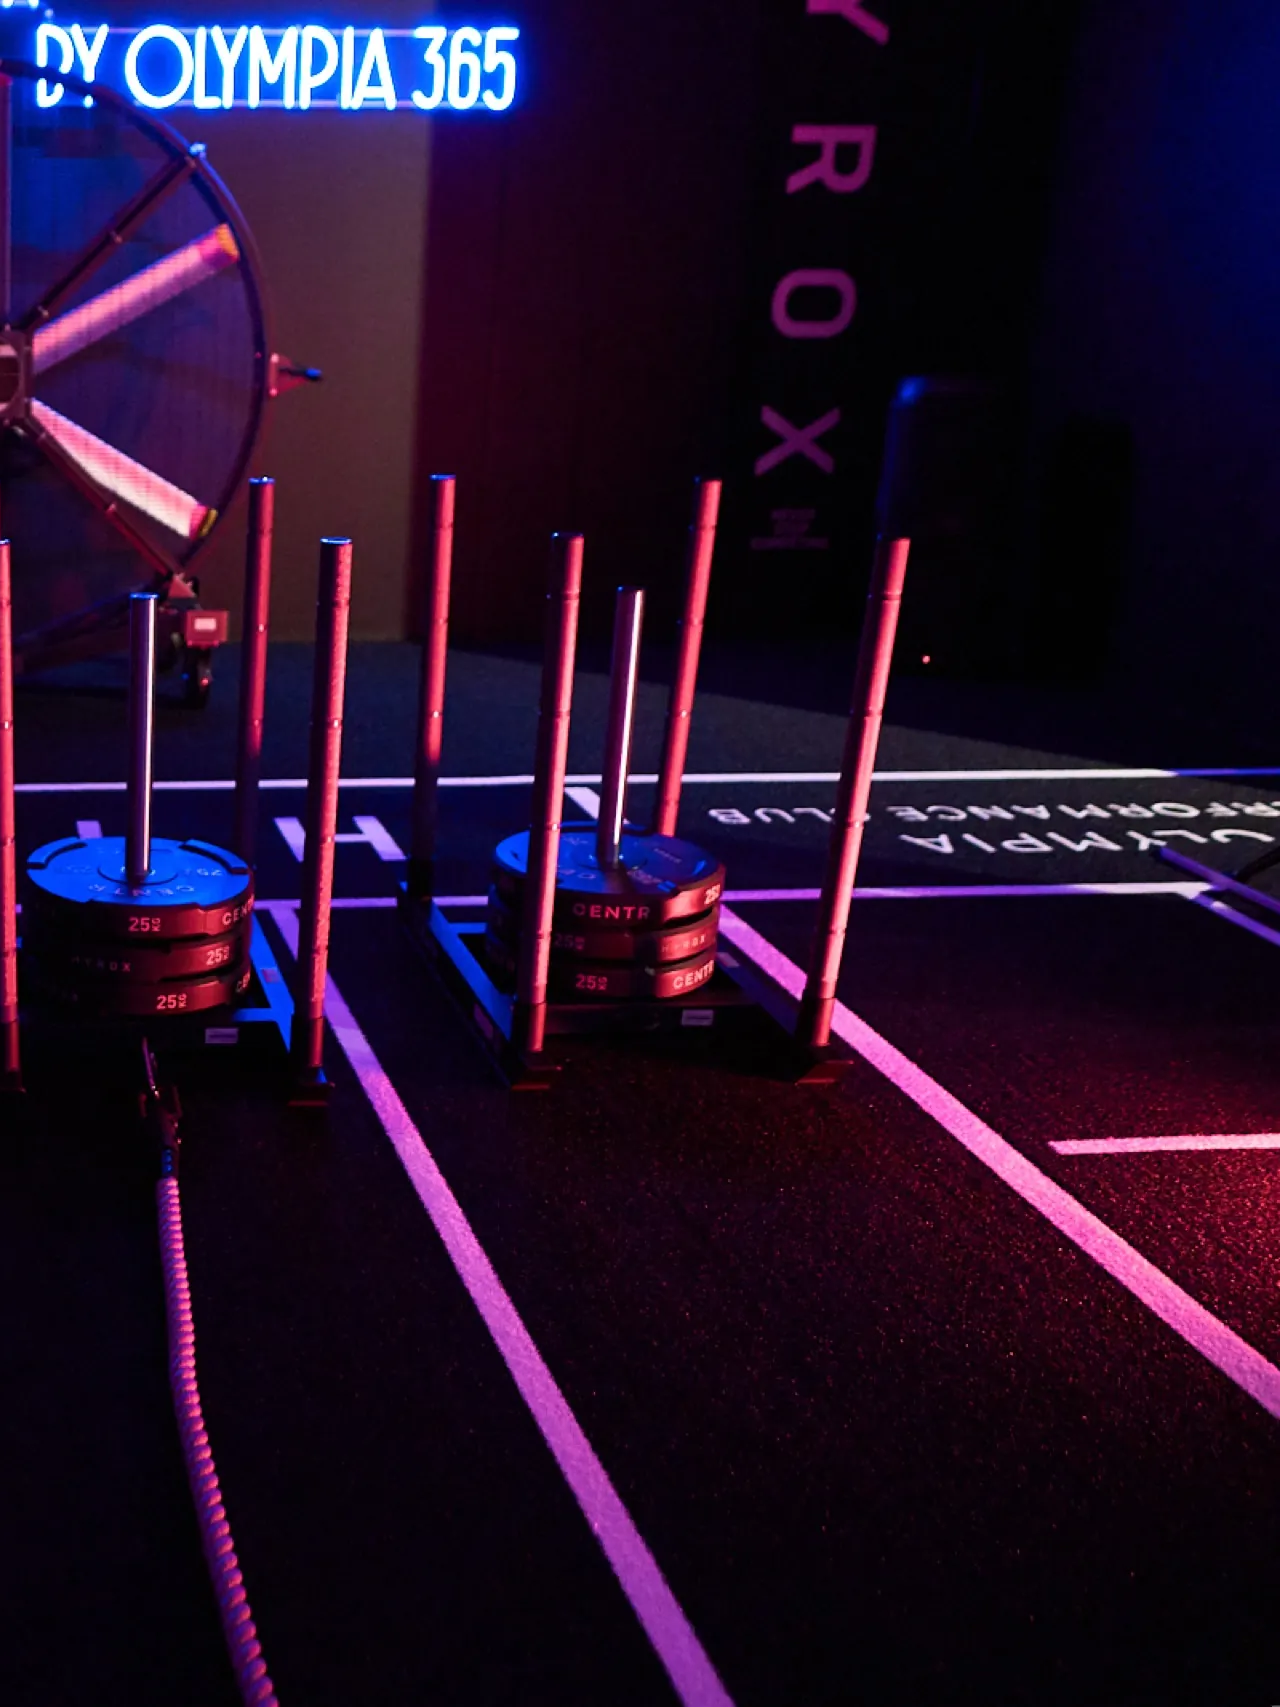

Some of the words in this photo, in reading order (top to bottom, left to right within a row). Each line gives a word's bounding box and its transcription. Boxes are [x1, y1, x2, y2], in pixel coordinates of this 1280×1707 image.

[35, 23, 109, 108] BY
[124, 23, 397, 110] OLYMPIA
[411, 26, 520, 111] 365
[571, 903, 652, 921] CENTR
